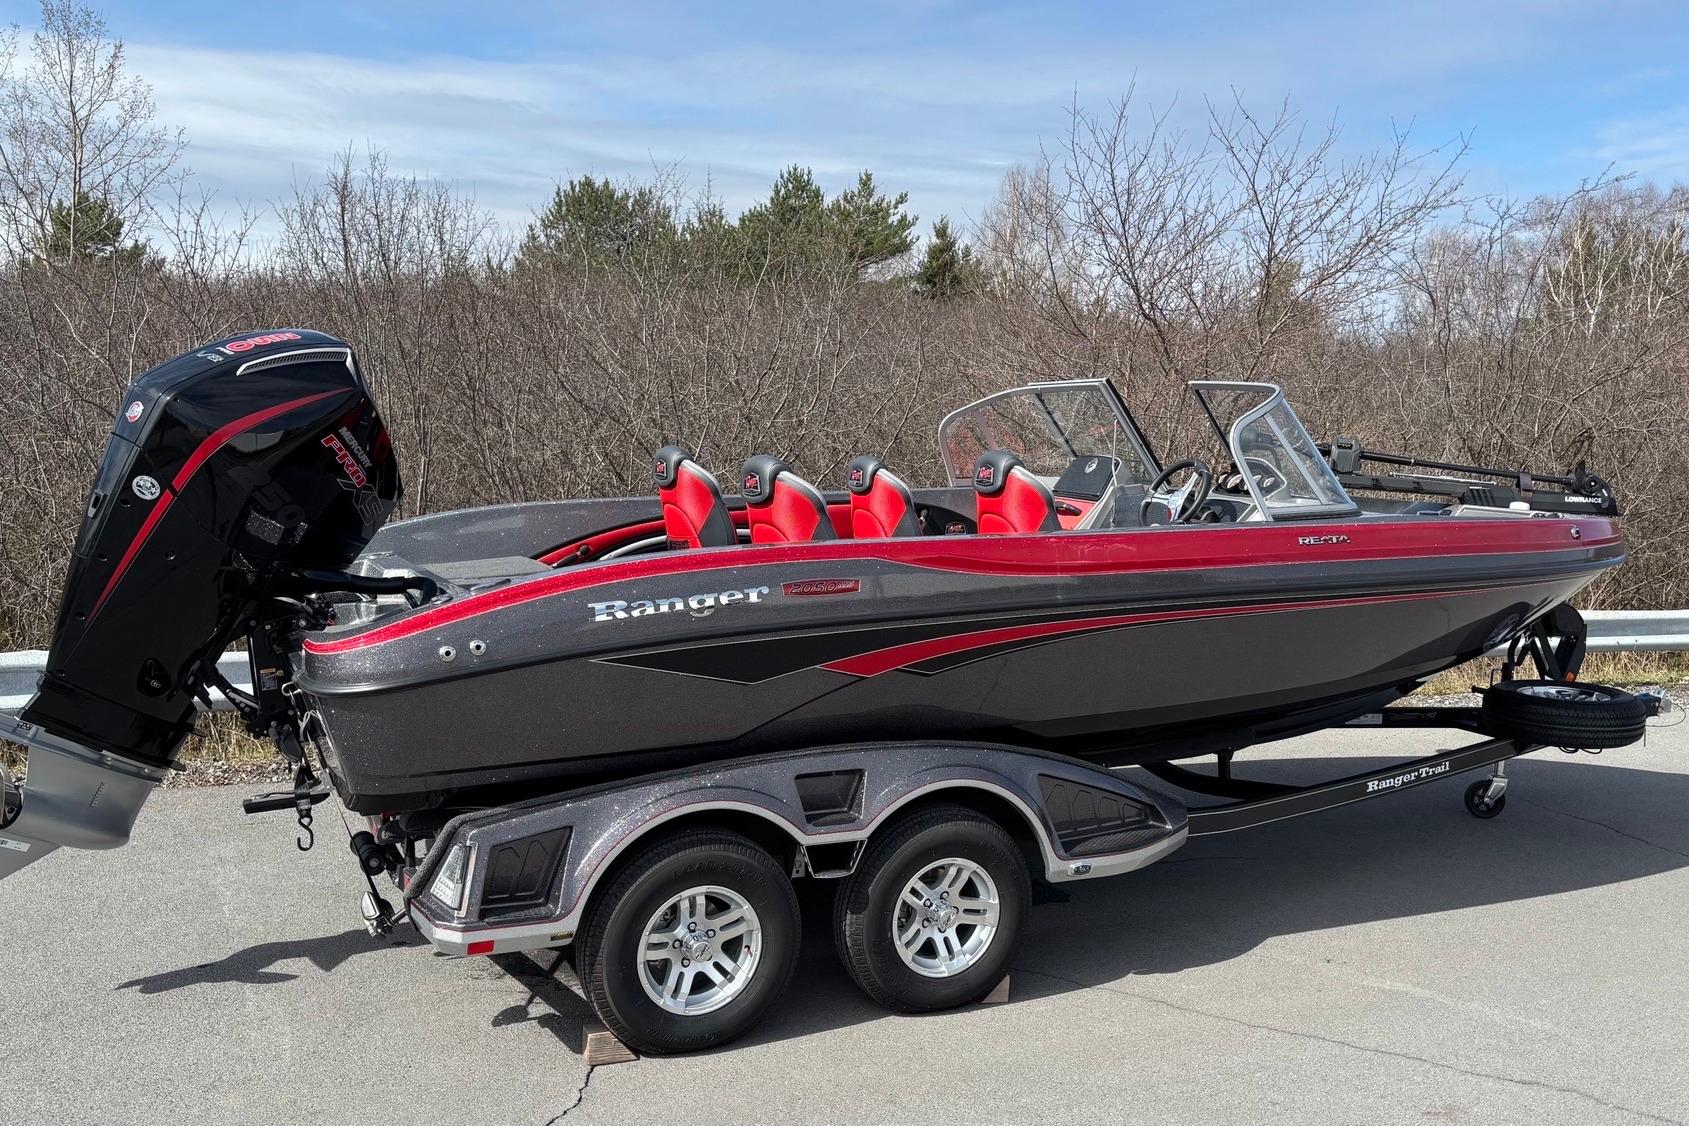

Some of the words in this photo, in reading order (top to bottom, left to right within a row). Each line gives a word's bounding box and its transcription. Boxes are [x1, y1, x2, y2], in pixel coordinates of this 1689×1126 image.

[320, 433, 368, 488] PRO
[338, 426, 373, 469] MERCURY
[336, 478, 384, 526] XS
[1564, 495, 1603, 504] LOWRANCE
[1297, 535, 1352, 545] REATA
[587, 585, 770, 622] Ranger
[788, 581, 838, 595] 2050
[1366, 770, 1418, 793] Ranger
[1419, 761, 1450, 778] Trail
